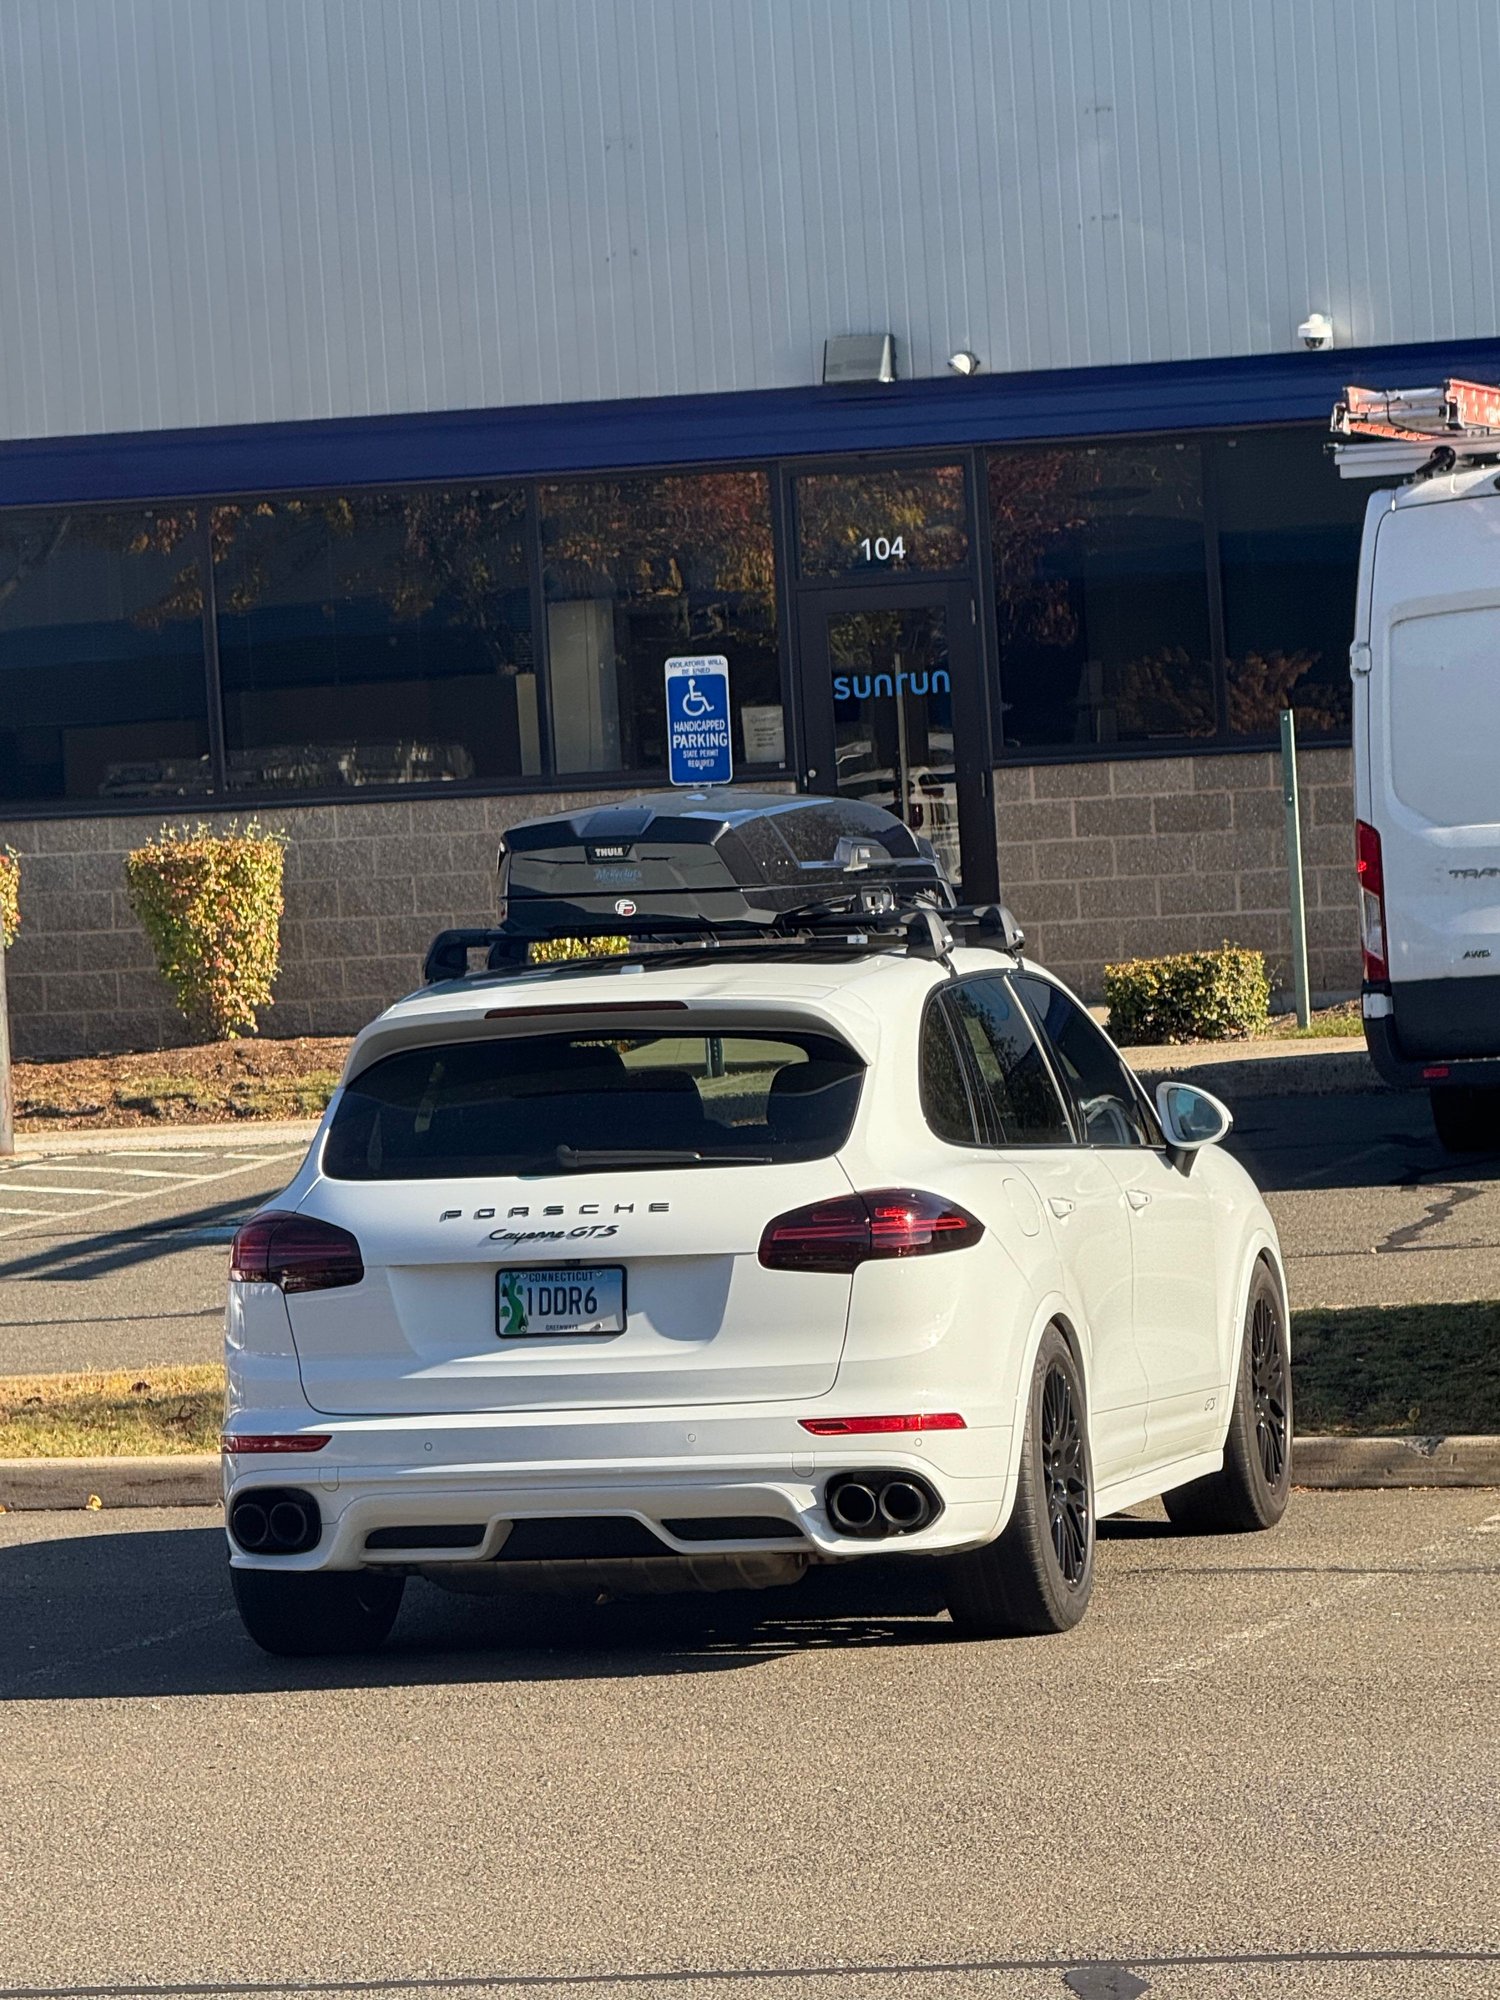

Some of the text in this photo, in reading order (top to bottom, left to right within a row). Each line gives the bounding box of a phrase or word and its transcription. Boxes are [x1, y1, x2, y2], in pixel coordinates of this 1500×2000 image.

[861, 536, 906, 561] 104
[833, 669, 950, 700] sunrun
[673, 719, 726, 732] HANDICAPPED
[672, 732, 728, 749] PARKING
[683, 748, 719, 759] STATE PERMIT
[595, 847, 623, 857] THULE
[1463, 949, 1491, 960] AWD
[441, 1202, 670, 1222] PORSCHE
[489, 1224, 619, 1245] Cayenne GTS
[528, 1271, 594, 1282] CONNECTICUT
[526, 1286, 598, 1317] 1DDR6
